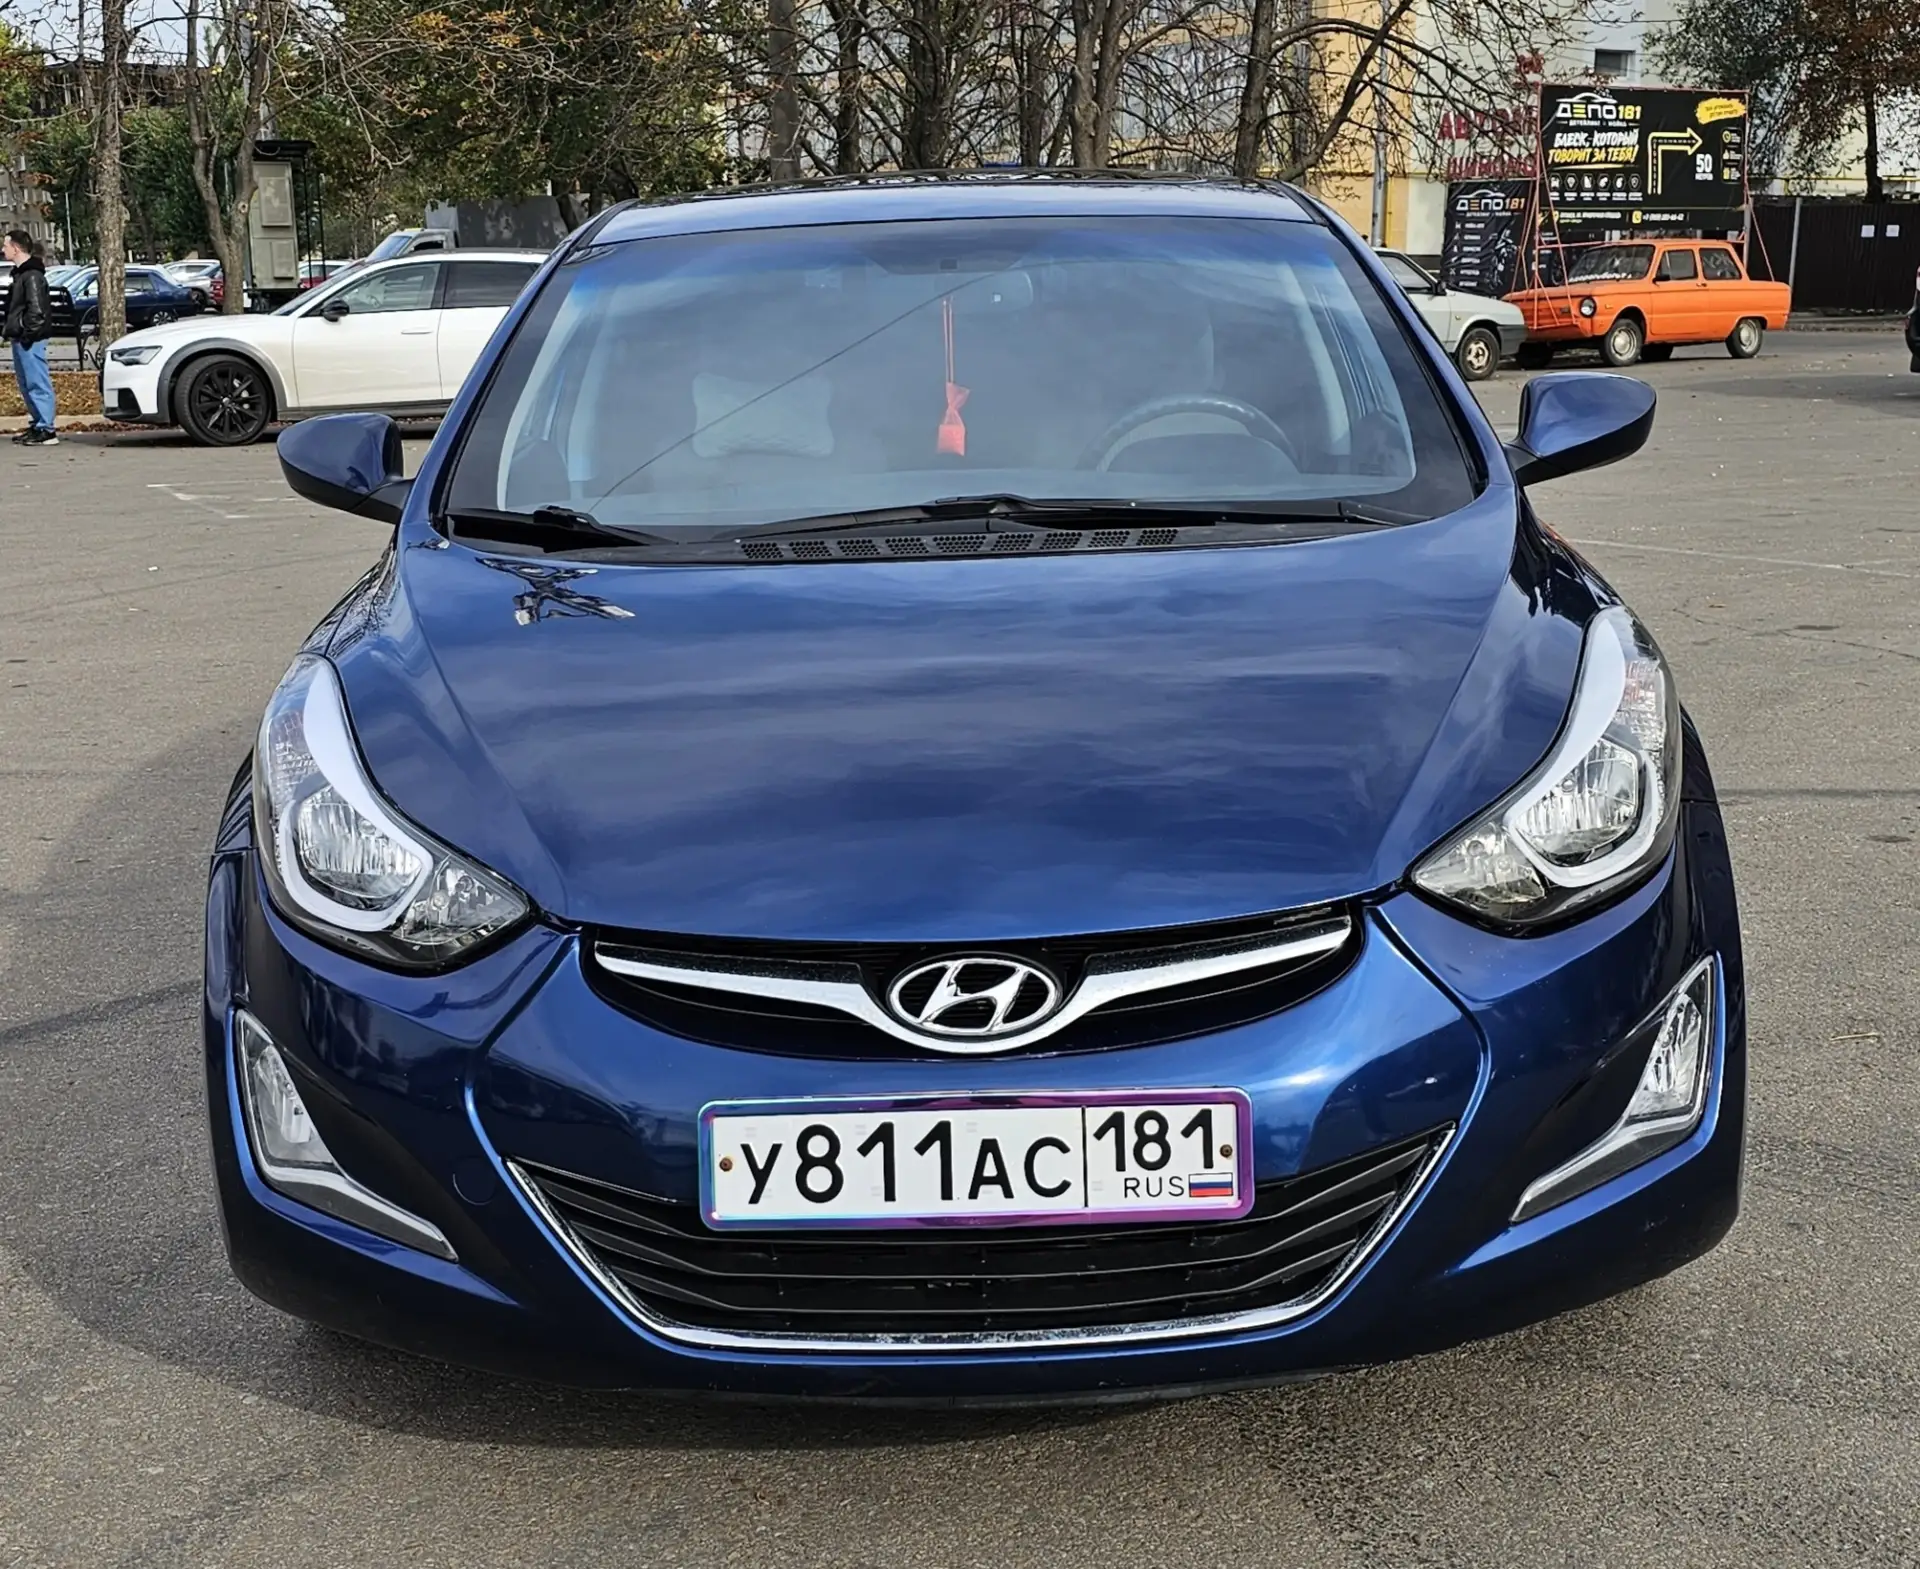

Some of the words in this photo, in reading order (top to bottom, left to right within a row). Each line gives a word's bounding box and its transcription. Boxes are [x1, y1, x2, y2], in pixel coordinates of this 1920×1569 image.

[1592, 128, 1639, 147] КОТОРЫЙ
[1548, 148, 1592, 164] ГОВОРИТ
[1592, 147, 1606, 162] ЗА
[1607, 144, 1639, 163] ТЕБЯ!
[1696, 153, 1713, 173] 50
[1092, 1108, 1215, 1172] 181
[1124, 1176, 1186, 1198] RUS
